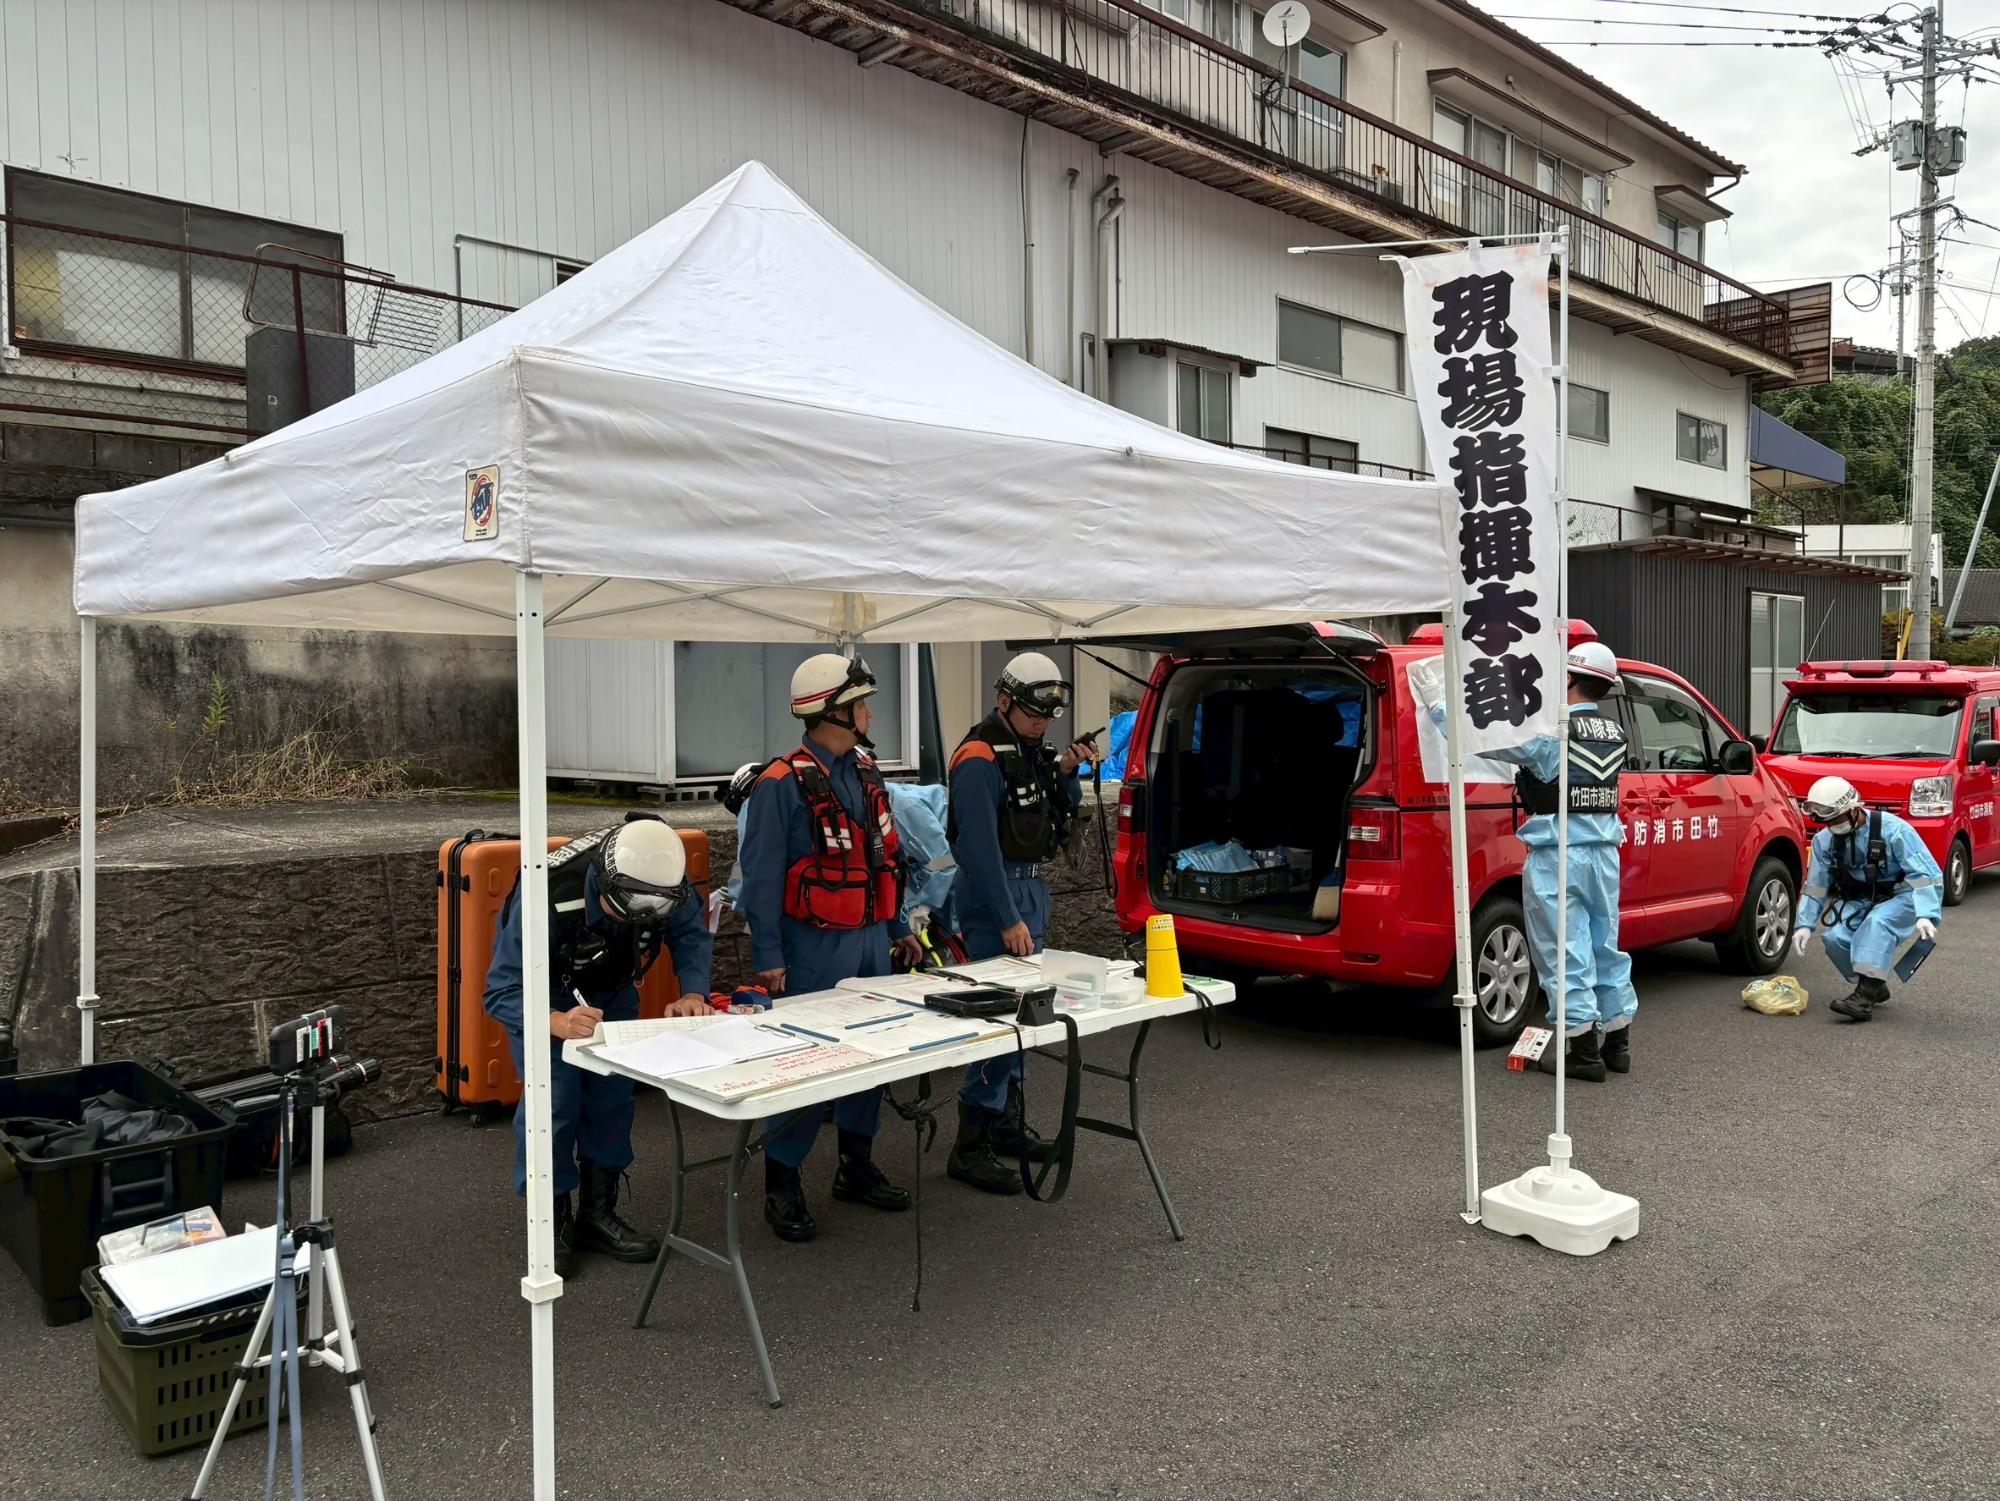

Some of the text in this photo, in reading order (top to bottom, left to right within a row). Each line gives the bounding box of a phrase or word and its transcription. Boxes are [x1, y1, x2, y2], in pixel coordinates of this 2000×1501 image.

[1431, 270, 1543, 730] 現場指揮本部
[1577, 716, 1621, 740] 小隊長
[1570, 786, 1618, 807] 竹田市消防本
